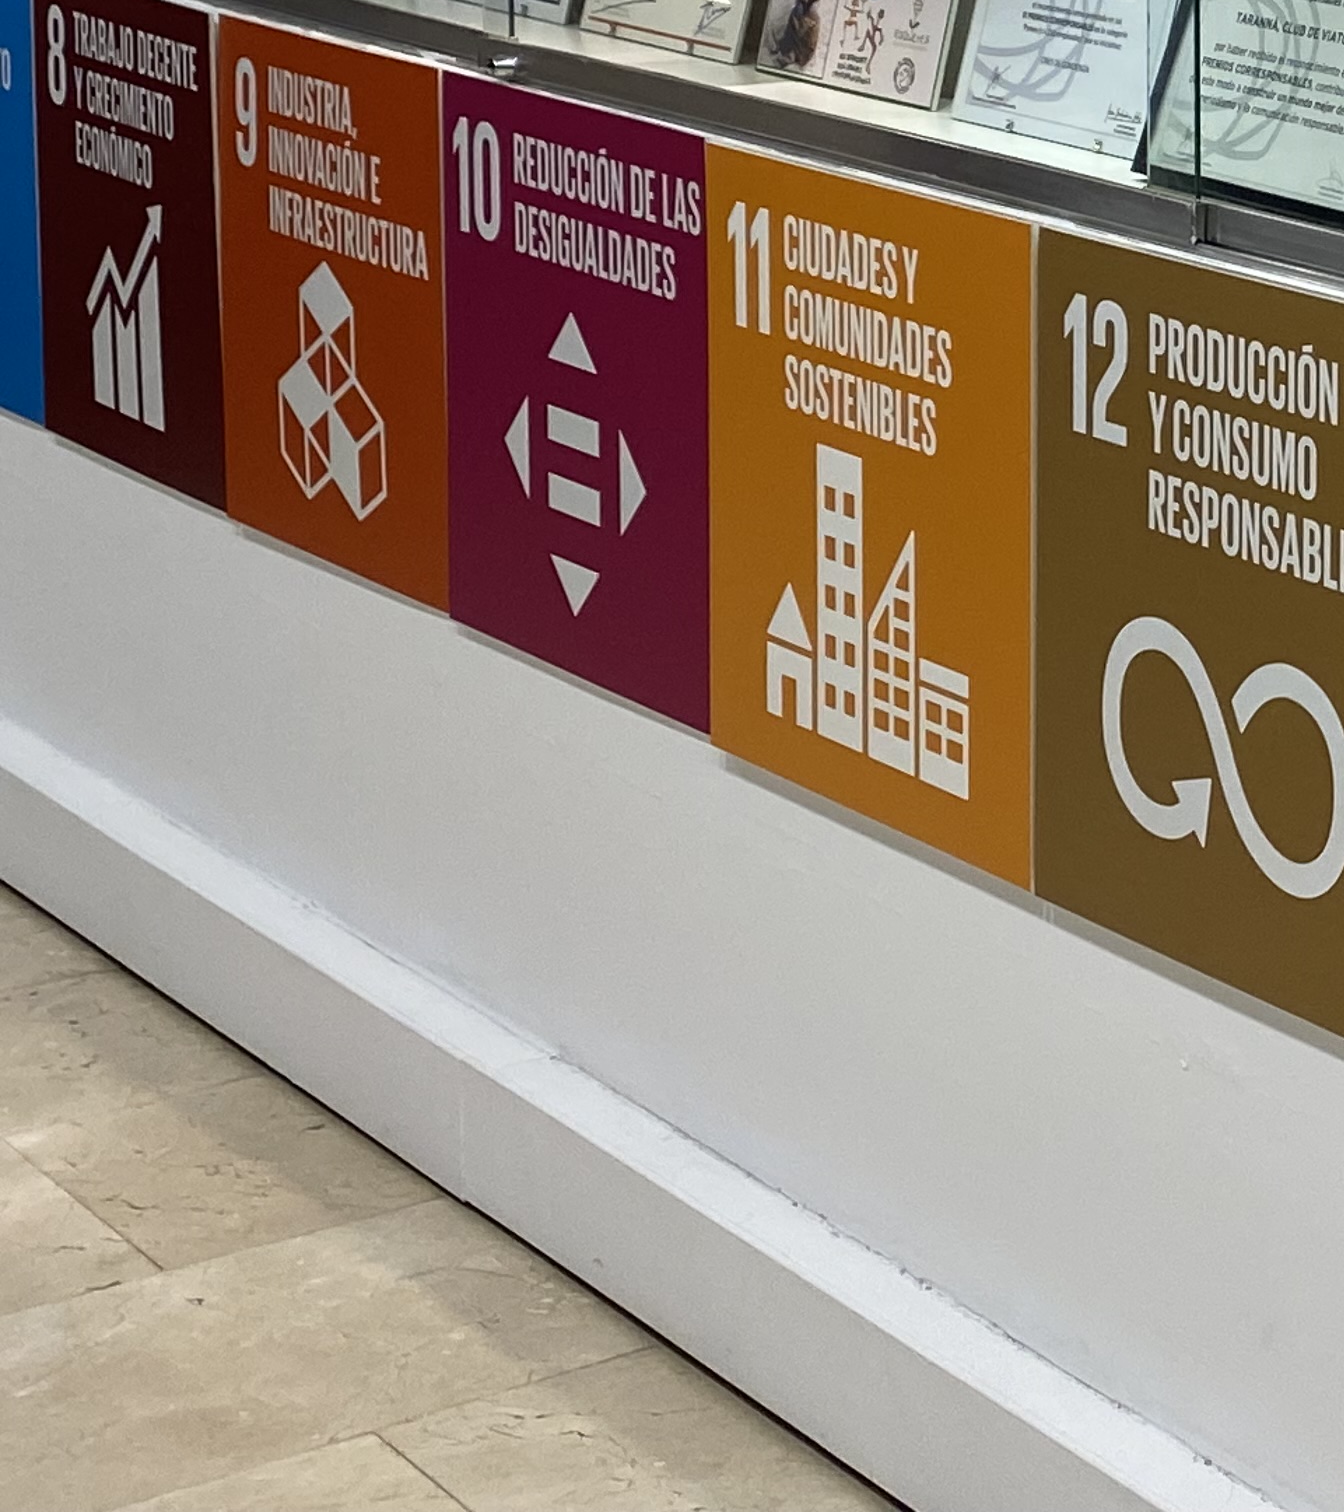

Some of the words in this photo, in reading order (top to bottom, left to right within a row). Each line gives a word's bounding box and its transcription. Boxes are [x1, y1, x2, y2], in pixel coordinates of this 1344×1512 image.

[46, 4, 67, 106] 8
[72, 10, 135, 72] TRABAJO
[136, 29, 199, 93] DECENTE
[266, 64, 358, 140] INDUSTRIA,
[73, 65, 84, 109] Y
[85, 69, 175, 142] CRECIMIENTO
[74, 120, 154, 190] ECONÓMICO
[234, 56, 259, 168] 9
[267, 124, 367, 201] INNOVACIÓN
[367, 154, 383, 205] E
[451, 114, 501, 243] 10
[512, 131, 626, 219] REDUCCIÓN
[629, 163, 658, 223] DE
[661, 170, 703, 237] LAS
[268, 186, 430, 282] INFRAESTRUCTURA
[514, 200, 676, 302] DESIGUALDADES
[726, 200, 771, 336] 11
[782, 213, 899, 301] CIUDADES
[900, 246, 919, 305] Y
[783, 284, 954, 390] COMUNIDADES
[1063, 291, 1129, 448] 12
[1148, 311, 1340, 426] PRODUCCIÓN
[784, 354, 938, 458] SOSTENIBLES
[1148, 390, 1168, 454] Y
[1172, 403, 1318, 503] CONSUMO
